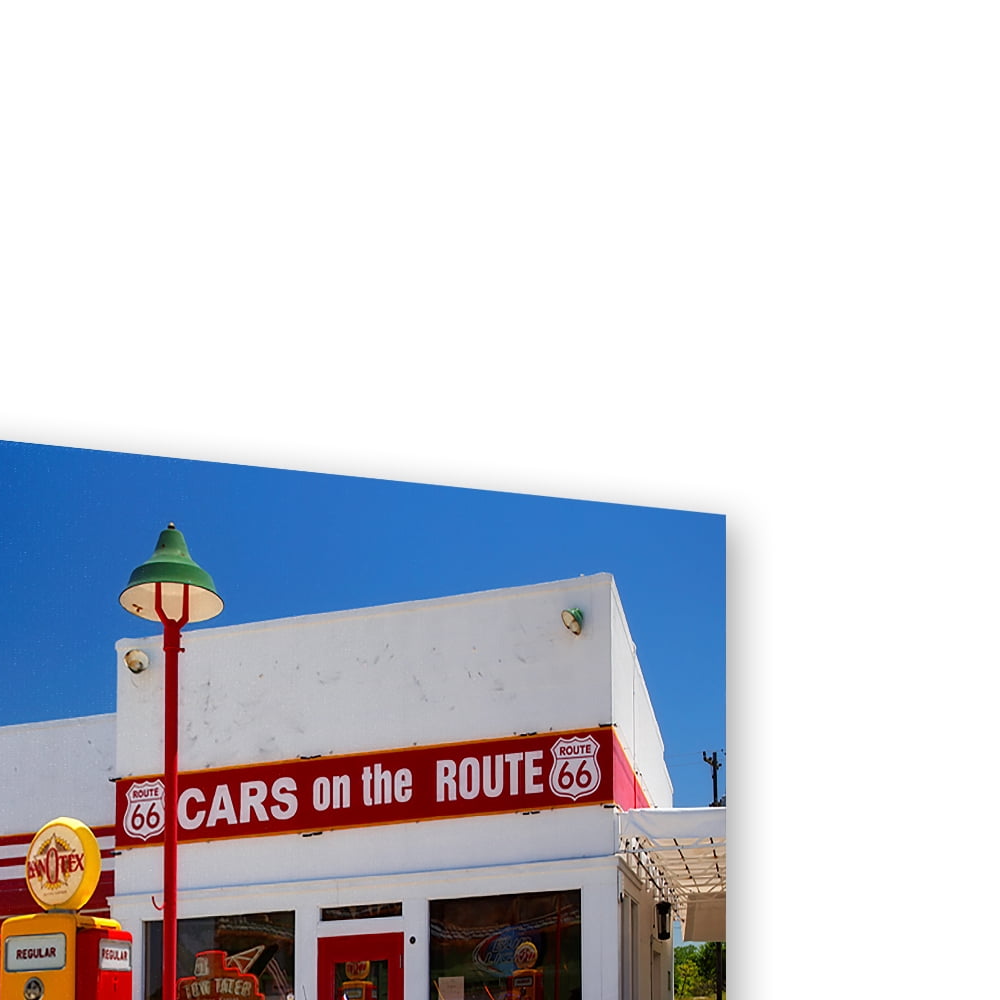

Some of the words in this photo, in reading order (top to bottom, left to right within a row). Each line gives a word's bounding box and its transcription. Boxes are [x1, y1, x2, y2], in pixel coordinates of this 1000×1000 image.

[560, 745, 591, 756] ROUTE
[558, 760, 592, 789] 66
[133, 787, 159, 798] ROUTE
[177, 777, 298, 830] CARS
[312, 774, 350, 811] on
[362, 763, 413, 806] the
[436, 750, 544, 802] ROUTE
[131, 802, 160, 830] 66
[16, 947, 57, 960] REGULAR
[102, 948, 128, 961] REGULAR
[185, 980, 210, 999] TOW
